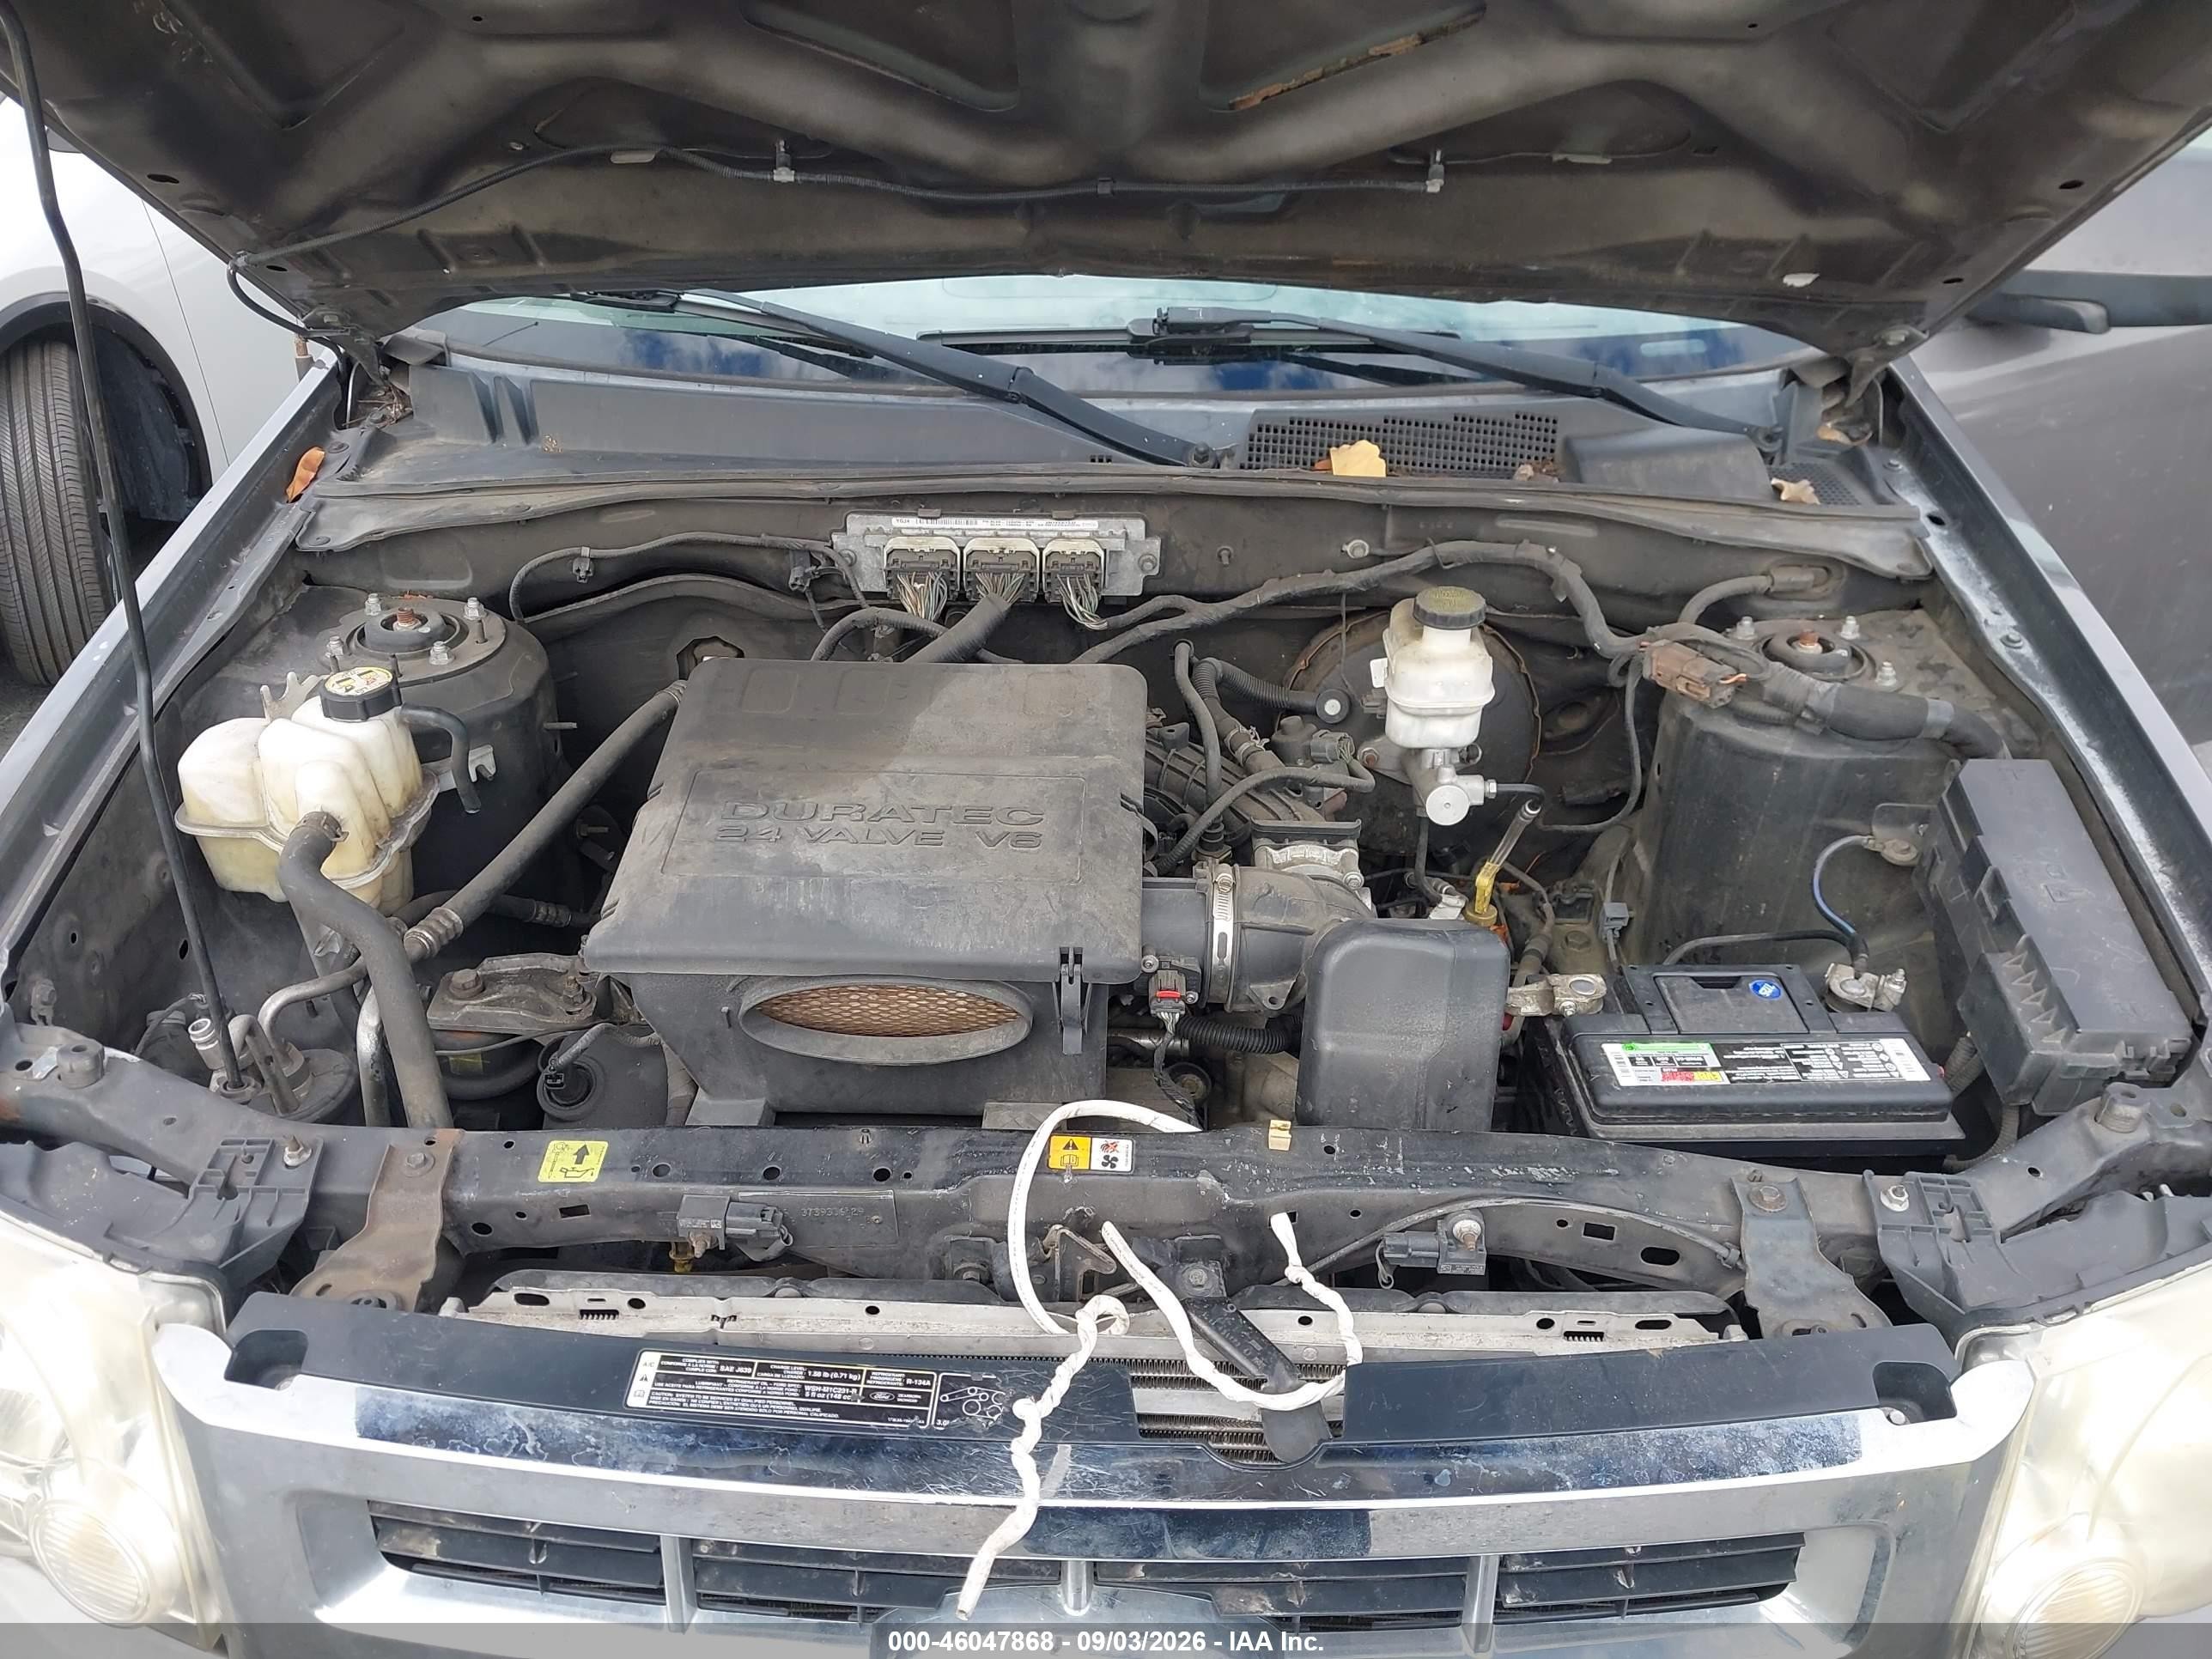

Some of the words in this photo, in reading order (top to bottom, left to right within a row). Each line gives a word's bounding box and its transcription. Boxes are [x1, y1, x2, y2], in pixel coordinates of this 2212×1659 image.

[720, 800, 1044, 826] DURATEC
[714, 825, 783, 843] 24
[796, 827, 945, 847] VALVE
[974, 830, 1042, 848] V6
[830, 1371, 847, 1380] (0.71
[906, 1377, 931, 1386] R-134A
